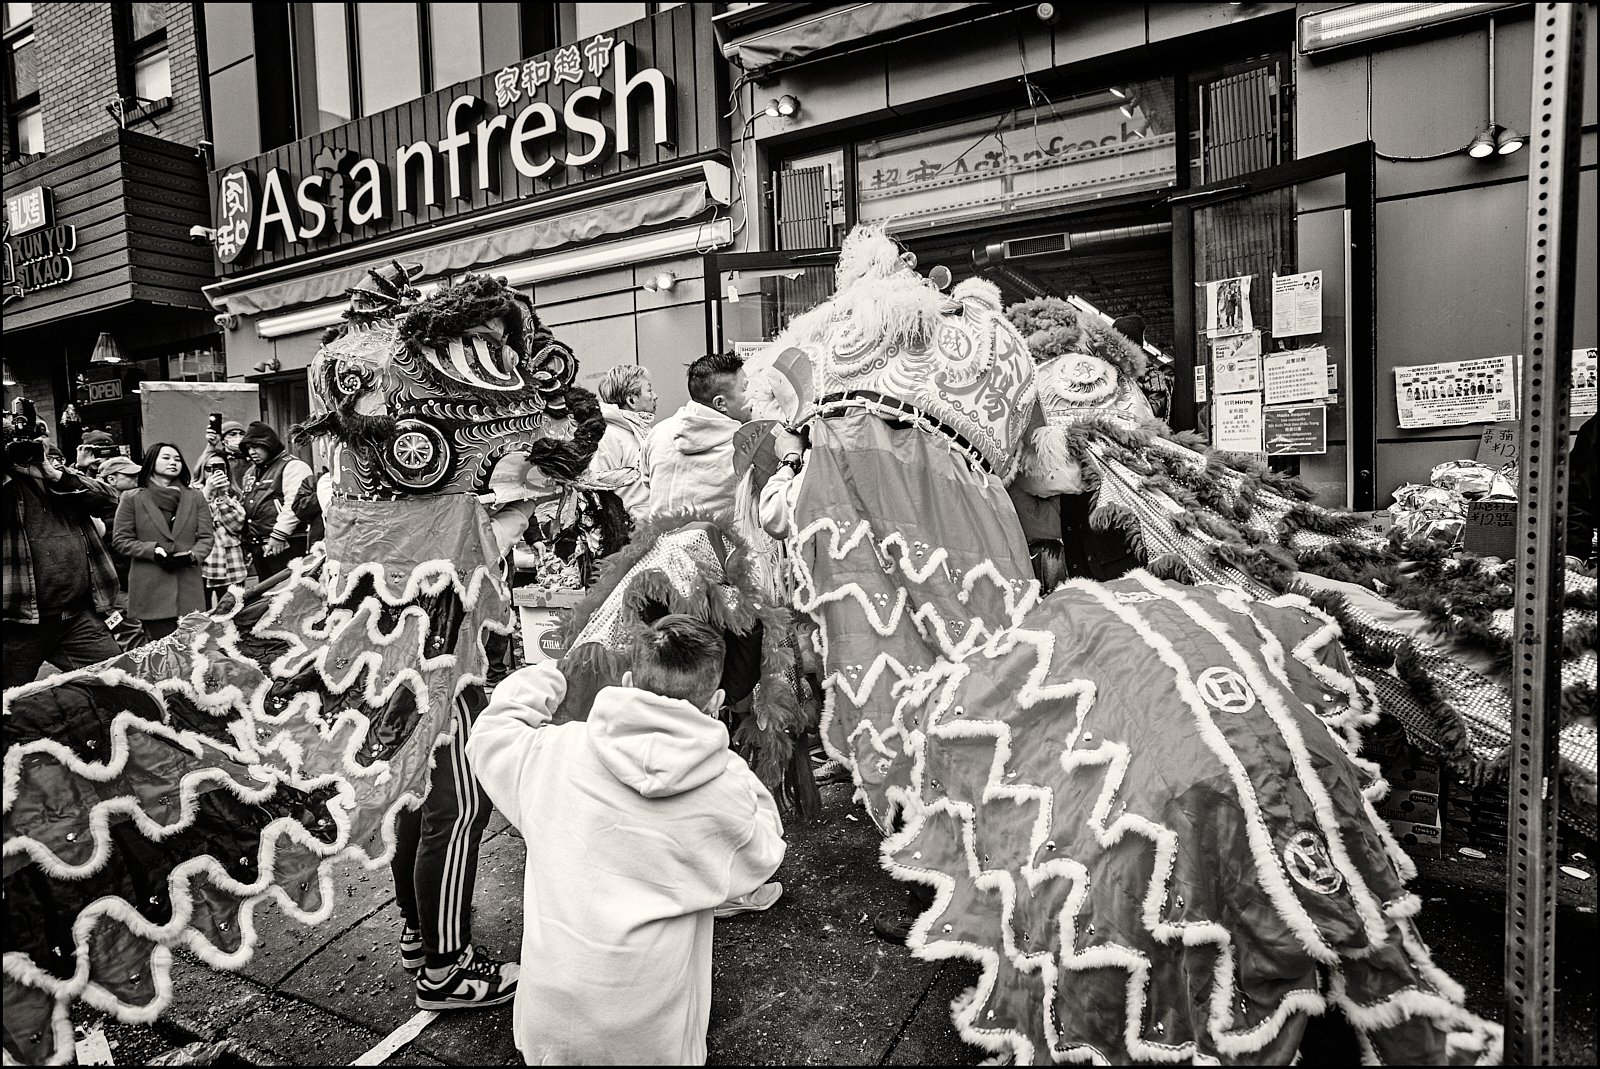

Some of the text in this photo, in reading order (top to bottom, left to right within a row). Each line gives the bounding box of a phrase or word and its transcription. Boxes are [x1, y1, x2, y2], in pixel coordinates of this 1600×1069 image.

[493, 34, 615, 109] 家和超市
[256, 40, 668, 250] Asianfresh
[44, 224, 66, 251] YU
[32, 255, 63, 284] KAO
[91, 382, 120, 400] OPEN
